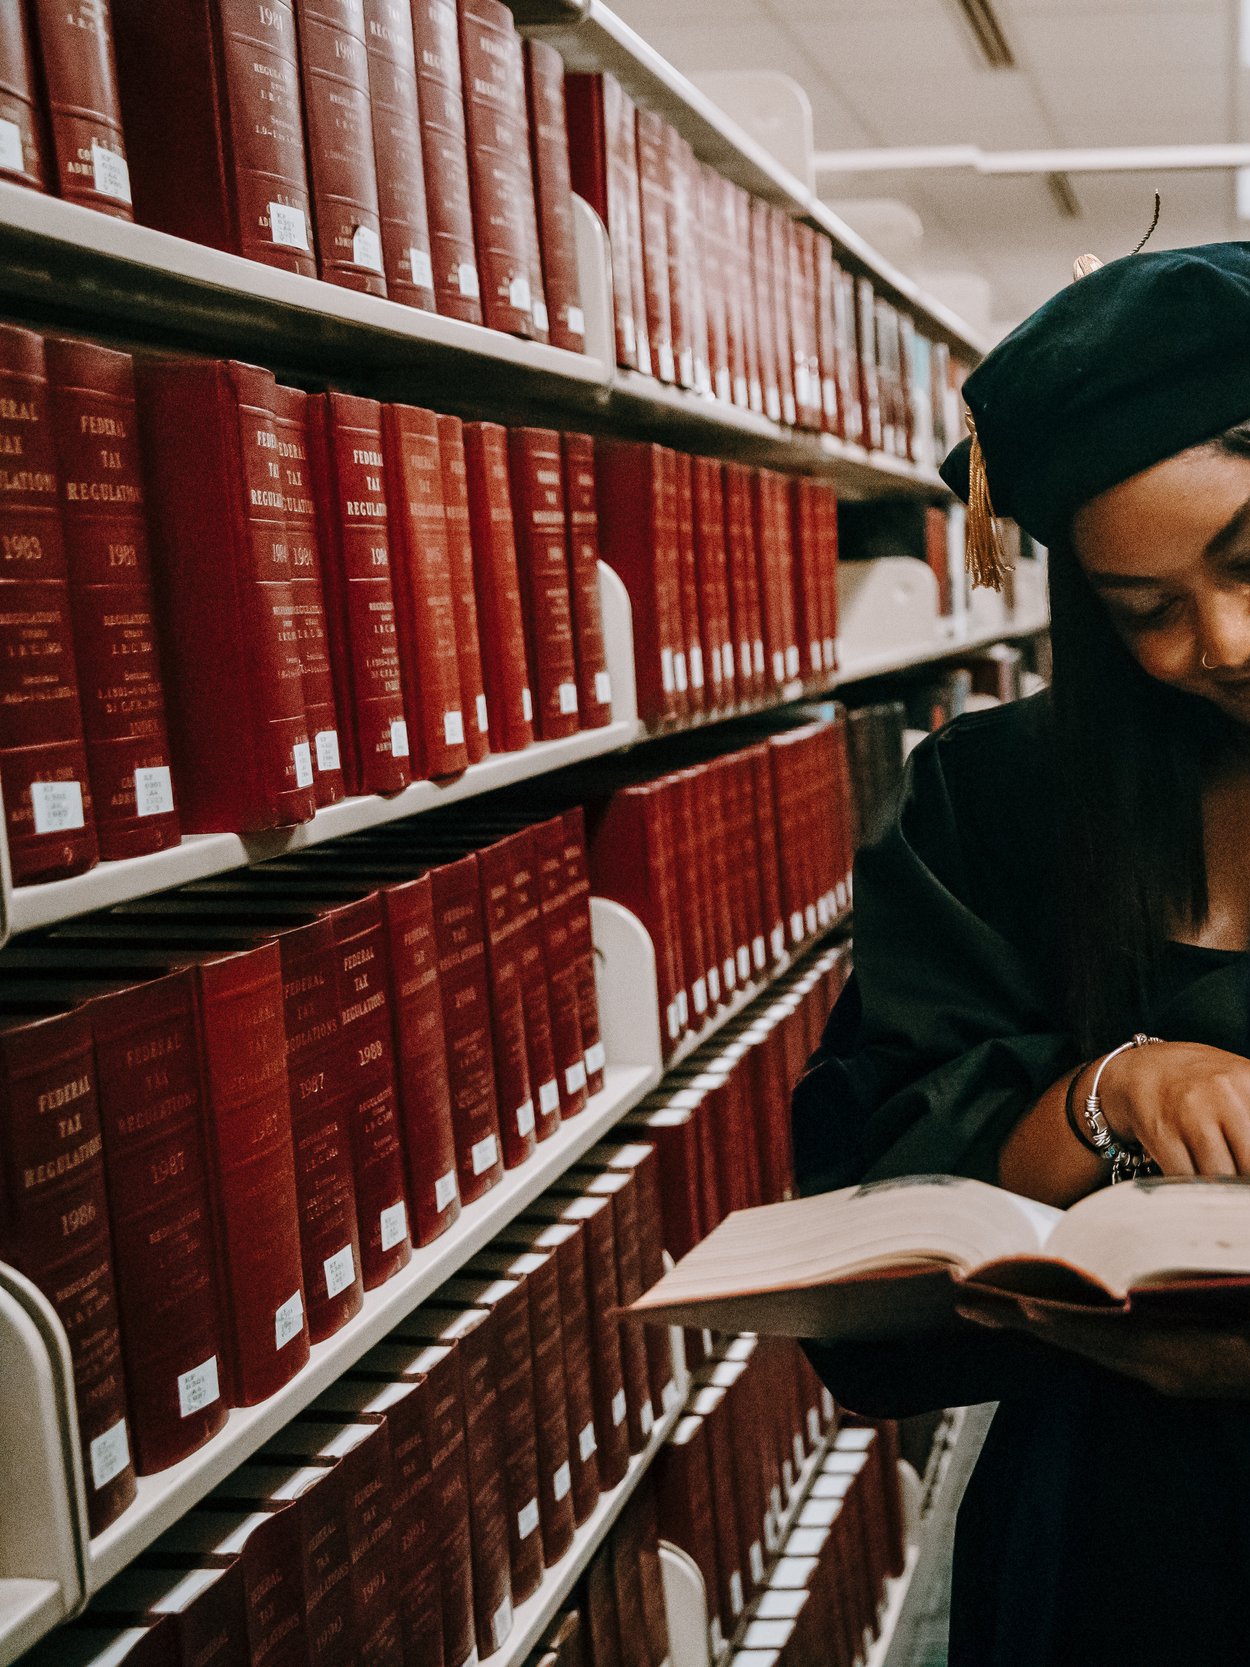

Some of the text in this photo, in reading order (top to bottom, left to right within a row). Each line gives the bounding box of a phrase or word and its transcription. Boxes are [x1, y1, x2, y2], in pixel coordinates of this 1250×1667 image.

[100, 450, 122, 469] TAX
[287, 470, 302, 486] TAX
[366, 476, 381, 492] TAX
[344, 946, 375, 971] FEDERAL
[354, 973, 369, 992] TAX
[342, 991, 386, 1026] REGULATIONS
[358, 1040, 383, 1067] 1988
[38, 1074, 91, 1114] FEDERAL
[58, 1112, 83, 1138] TAX
[151, 1150, 185, 1184] 1987
